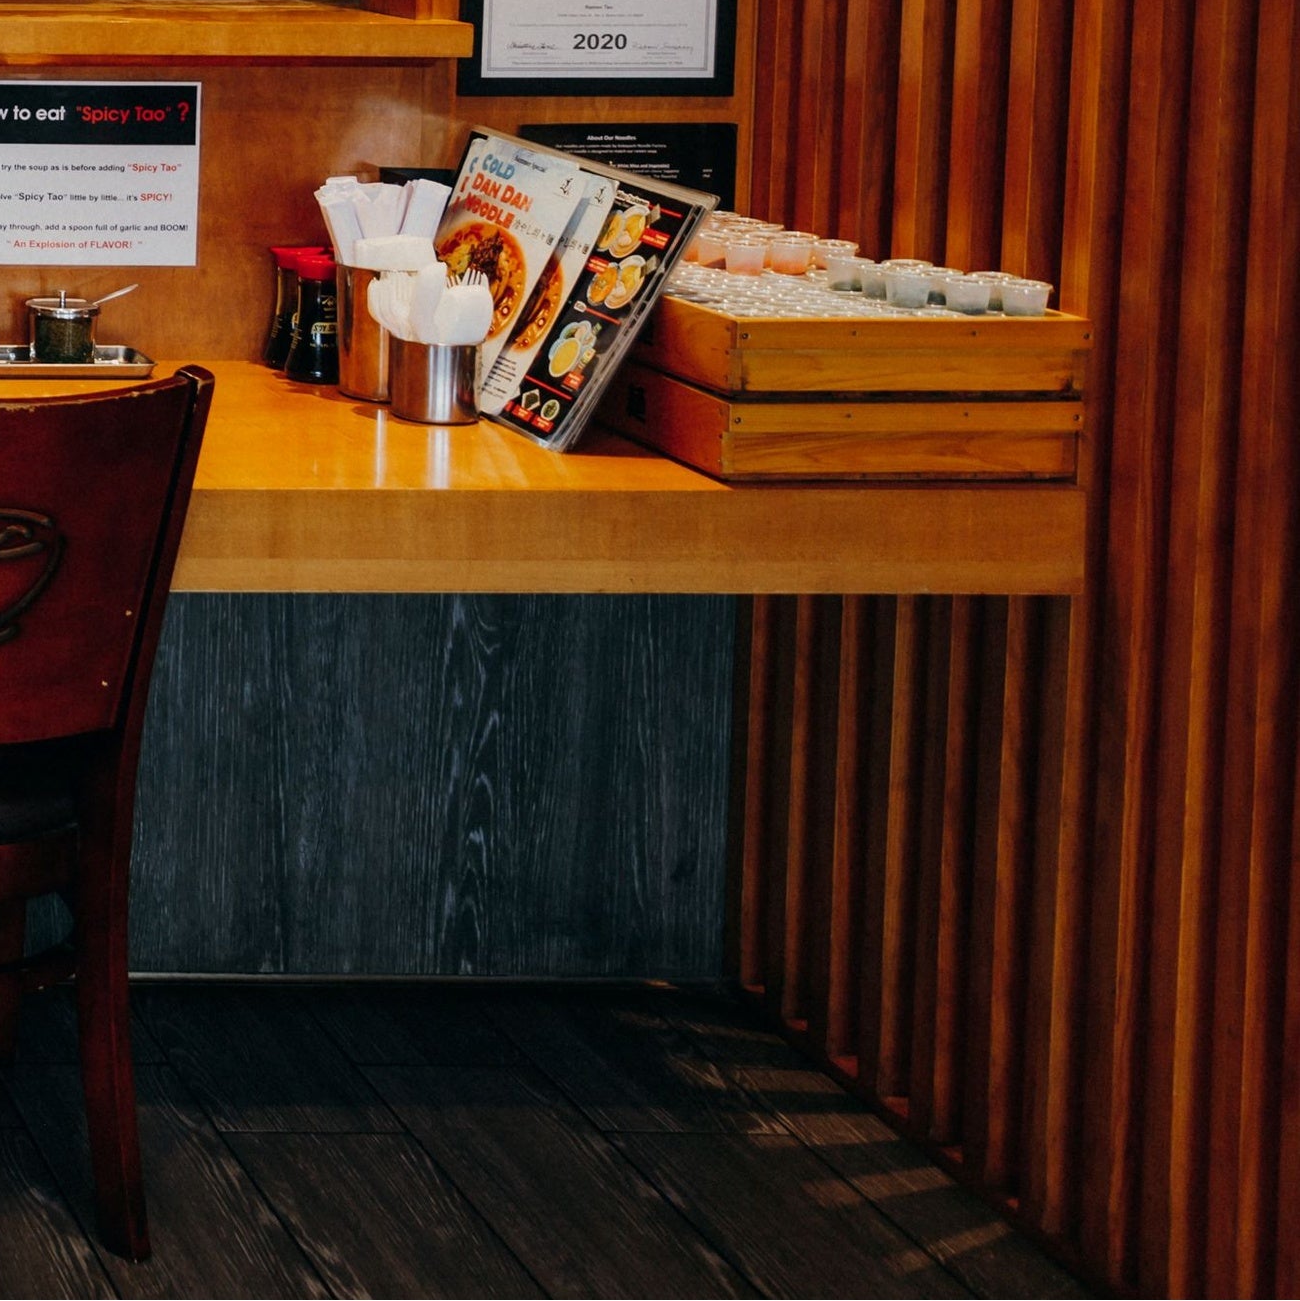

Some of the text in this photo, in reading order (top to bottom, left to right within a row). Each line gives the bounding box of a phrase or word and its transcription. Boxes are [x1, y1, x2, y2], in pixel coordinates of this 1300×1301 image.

[573, 33, 627, 50] 2020
[13, 105, 32, 121] to
[35, 105, 66, 121] eat
[76, 105, 131, 124] "Spicy
[134, 105, 172, 121] Tao"
[177, 101, 189, 121] ?
[1, 164, 12, 172] try
[14, 163, 27, 171] the
[71, 163, 96, 171] before
[98, 163, 125, 173] adding
[128, 163, 158, 173] "Spicy
[161, 163, 182, 172] Tao"
[482, 153, 515, 180] COLD
[15, 192, 45, 202] "Spicy
[48, 193, 68, 201] Tao"
[70, 193, 87, 201] little
[89, 193, 99, 202] by
[140, 193, 173, 202] SPICY!
[472, 172, 534, 213] DAN DAN
[464, 191, 516, 230] NOODLE
[45, 223, 60, 231] add
[68, 224, 93, 232] spoon
[95, 223, 108, 231] full
[110, 223, 118, 231] of
[120, 224, 141, 232] garlic
[143, 224, 158, 232] and
[13, 240, 132, 250] An Explosion of FLAVOR!
